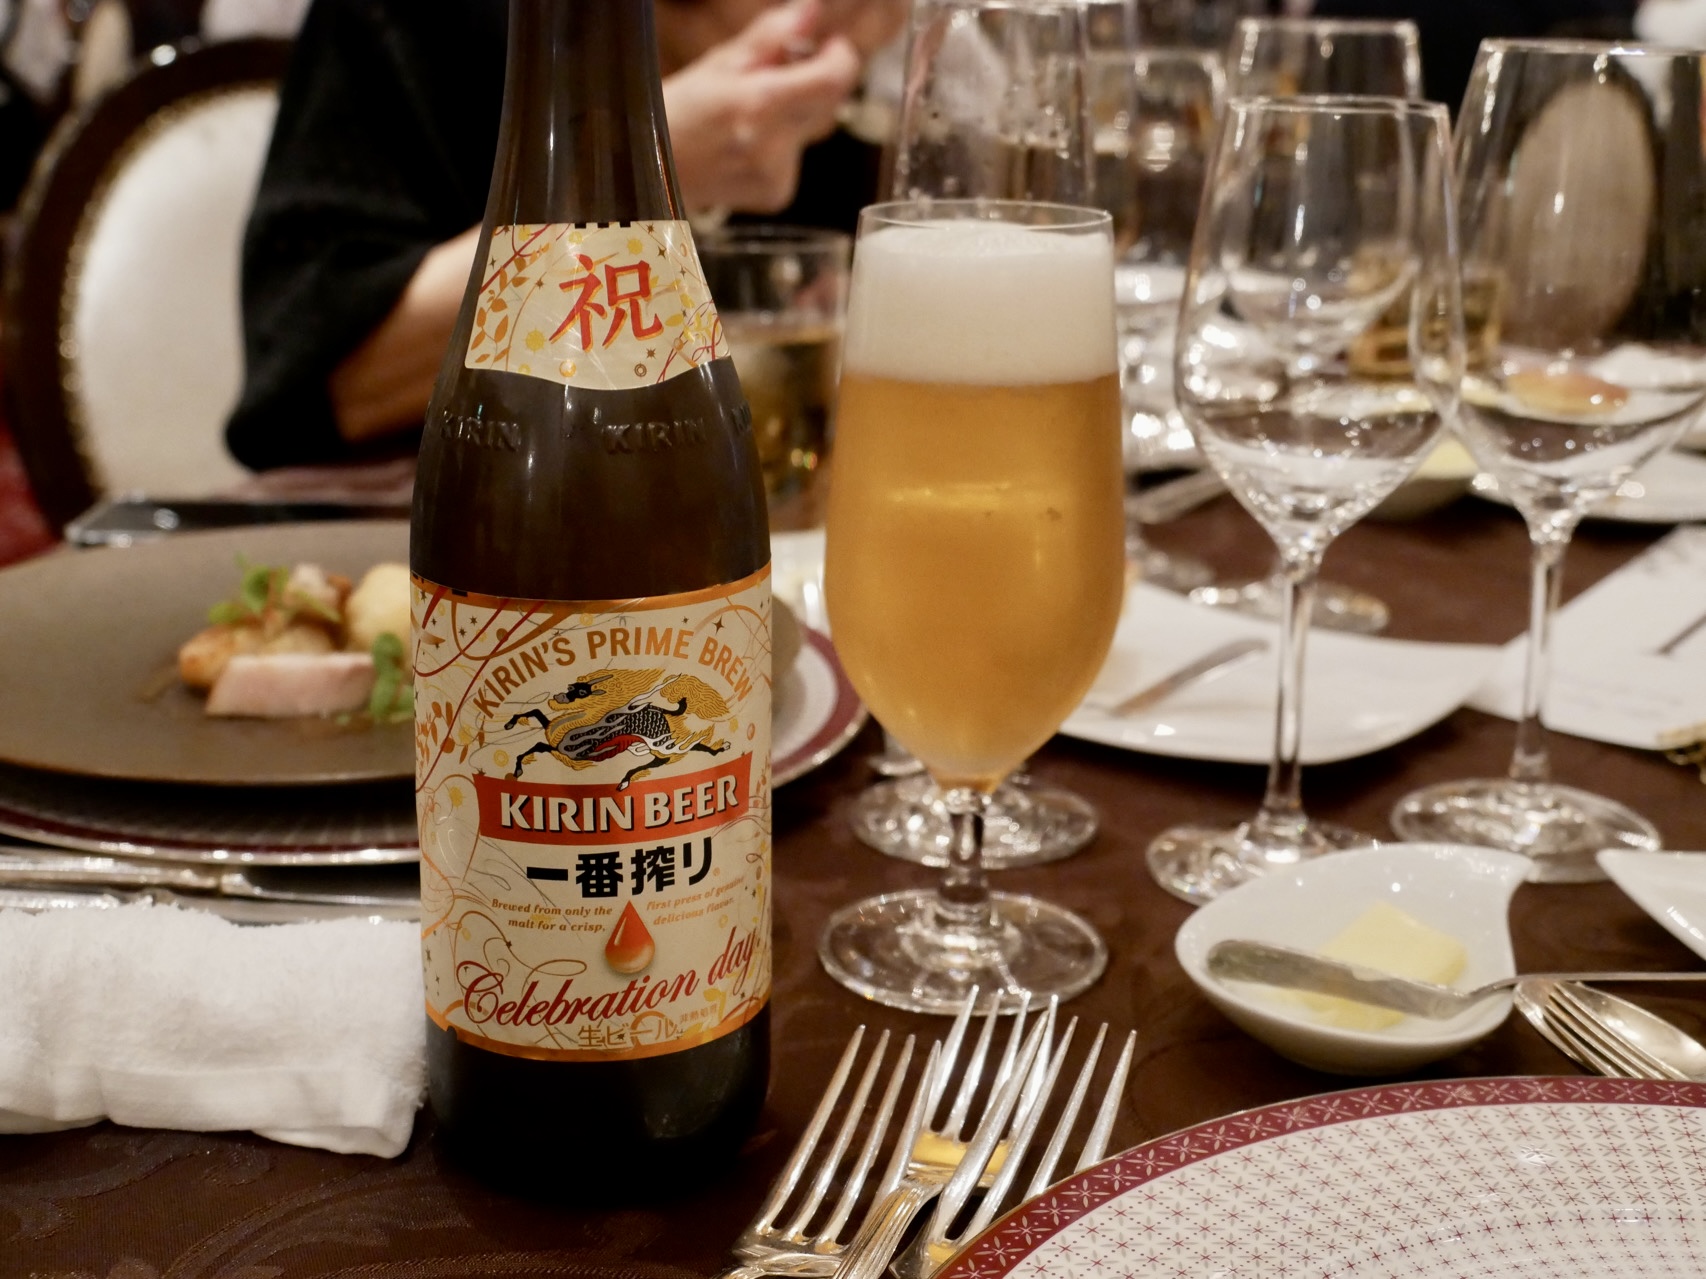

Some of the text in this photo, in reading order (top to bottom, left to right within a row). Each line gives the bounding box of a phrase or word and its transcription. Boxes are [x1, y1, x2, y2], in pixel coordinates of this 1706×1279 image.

[548, 253, 664, 353] 祝
[473, 627, 753, 719] KIRIN'S PRIME BREW
[501, 774, 739, 834] KIRIN BEER
[491, 899, 613, 918] Brewed from only the
[646, 900, 671, 911] first
[674, 893, 702, 908] press
[704, 887, 715, 898] of
[508, 920, 534, 929] malt
[537, 921, 557, 931] for
[559, 923, 567, 931] a
[653, 908, 704, 925] delicious
[456, 926, 758, 1026] Celebration day
[578, 1019, 677, 1047] 生ビール
